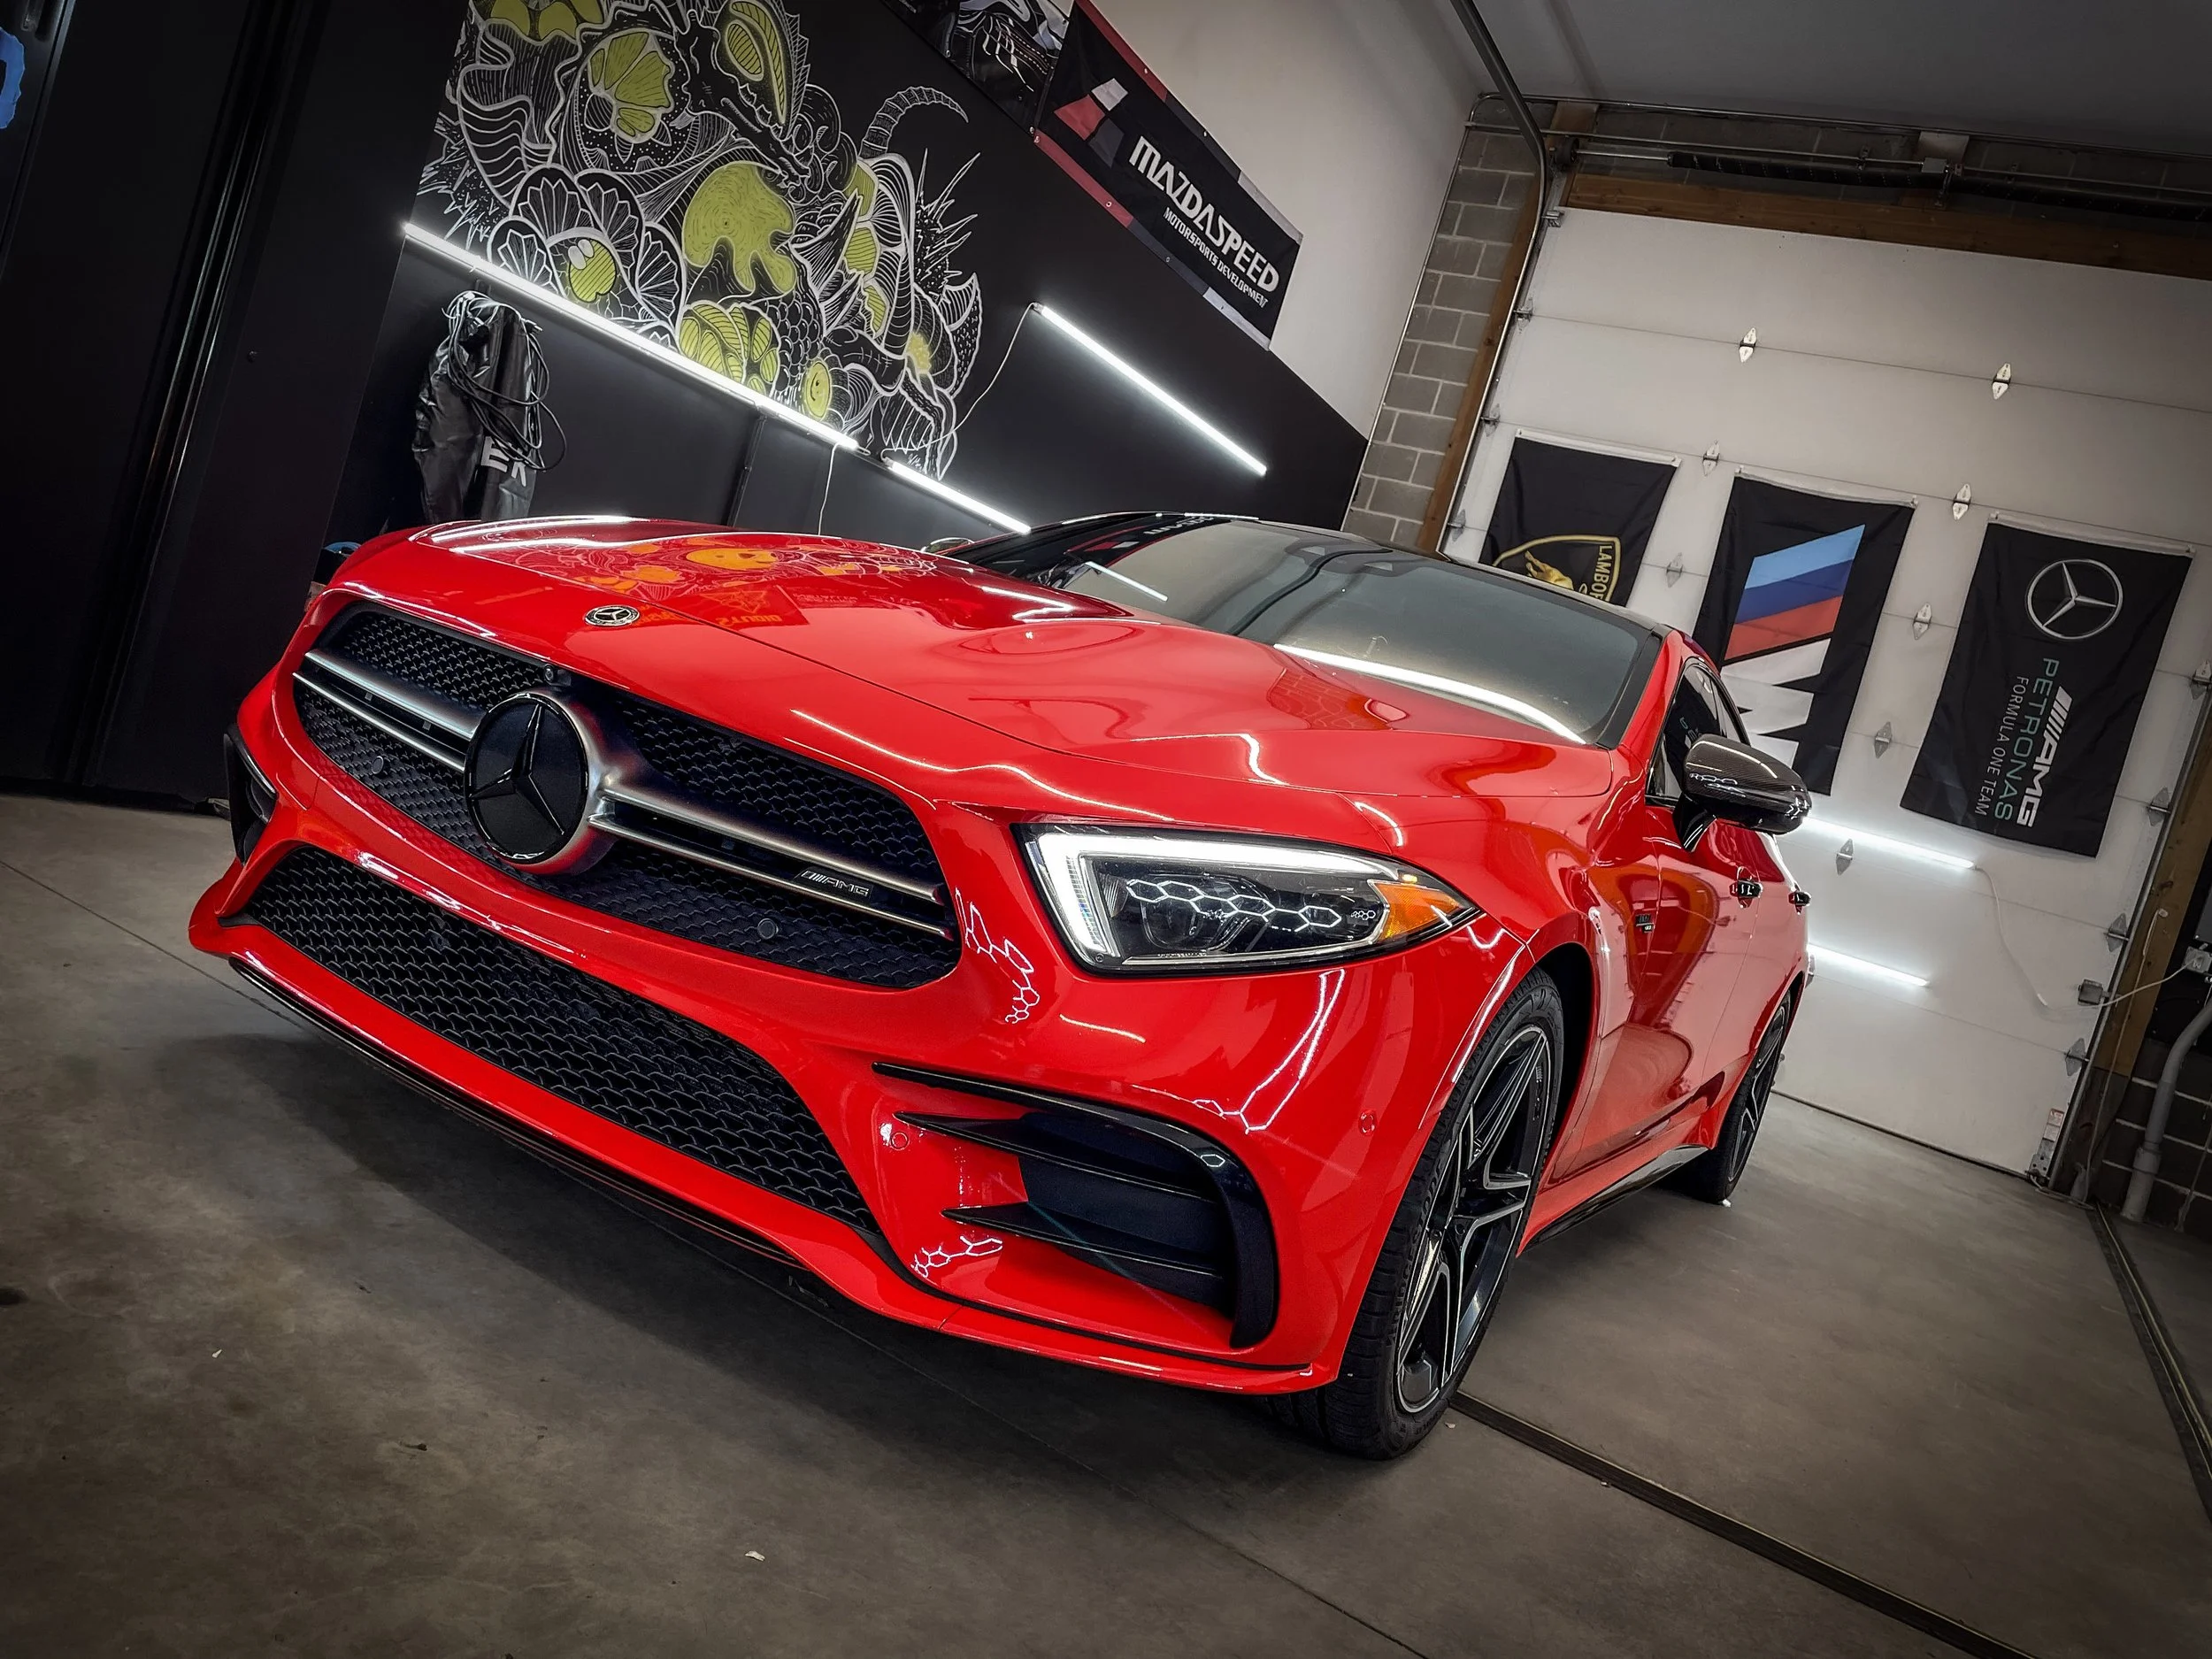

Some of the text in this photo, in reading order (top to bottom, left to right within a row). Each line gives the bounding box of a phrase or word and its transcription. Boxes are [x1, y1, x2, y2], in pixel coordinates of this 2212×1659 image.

[1128, 135, 1280, 293] MAZDASPEED
[1163, 207, 1269, 309] MOTORSPORTS DEVELOPMENT
[1974, 675, 2030, 817] FORMULA ONE TEAM
[1994, 657, 2060, 821] PETRONAS
[2016, 733, 2057, 828] AMG
